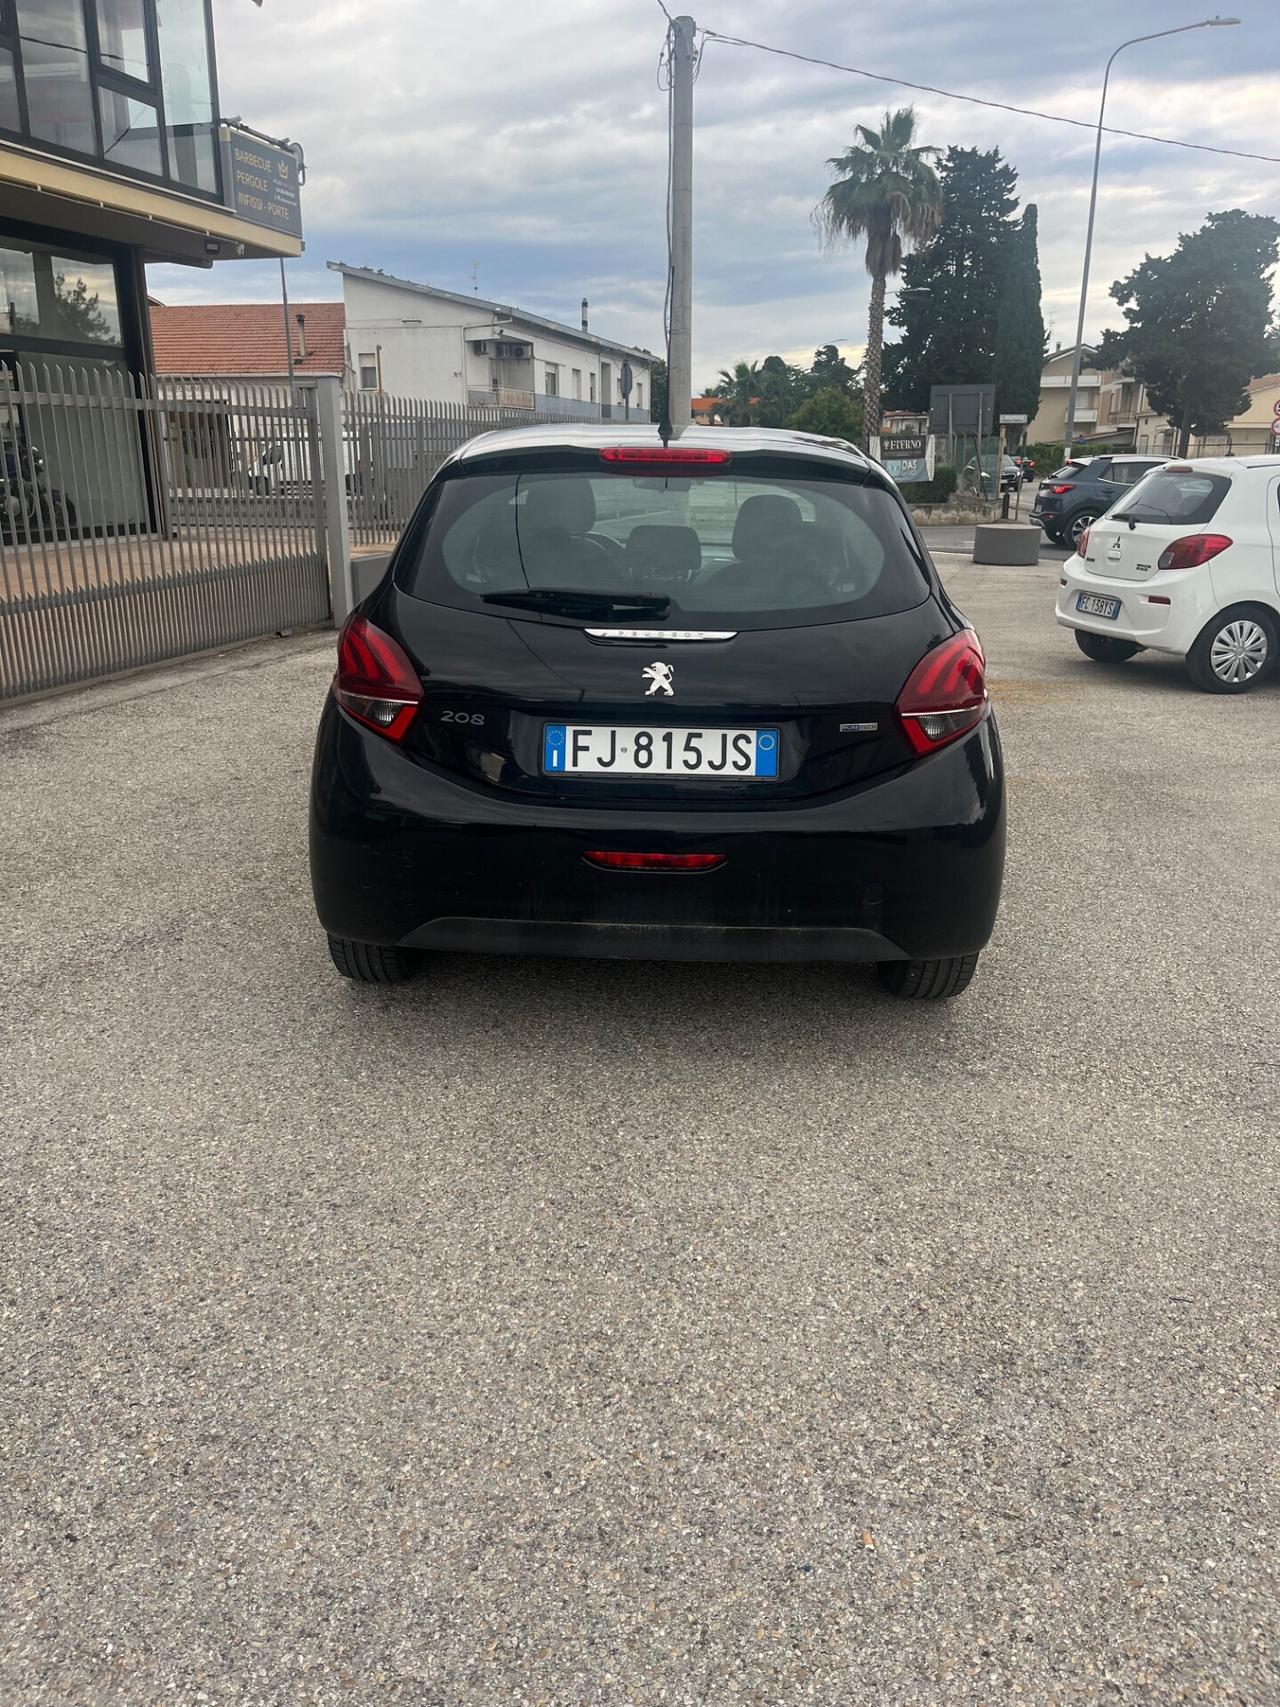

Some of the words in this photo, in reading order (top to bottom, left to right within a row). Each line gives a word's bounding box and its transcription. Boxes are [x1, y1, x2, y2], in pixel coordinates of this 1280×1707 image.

[235, 148, 272, 173] BARBECUE
[236, 170, 268, 192] PERGOLE
[238, 192, 263, 211] INFISSI
[268, 202, 289, 219] PORTE
[890, 439, 921, 450] ETERNO
[440, 710, 485, 726] 208
